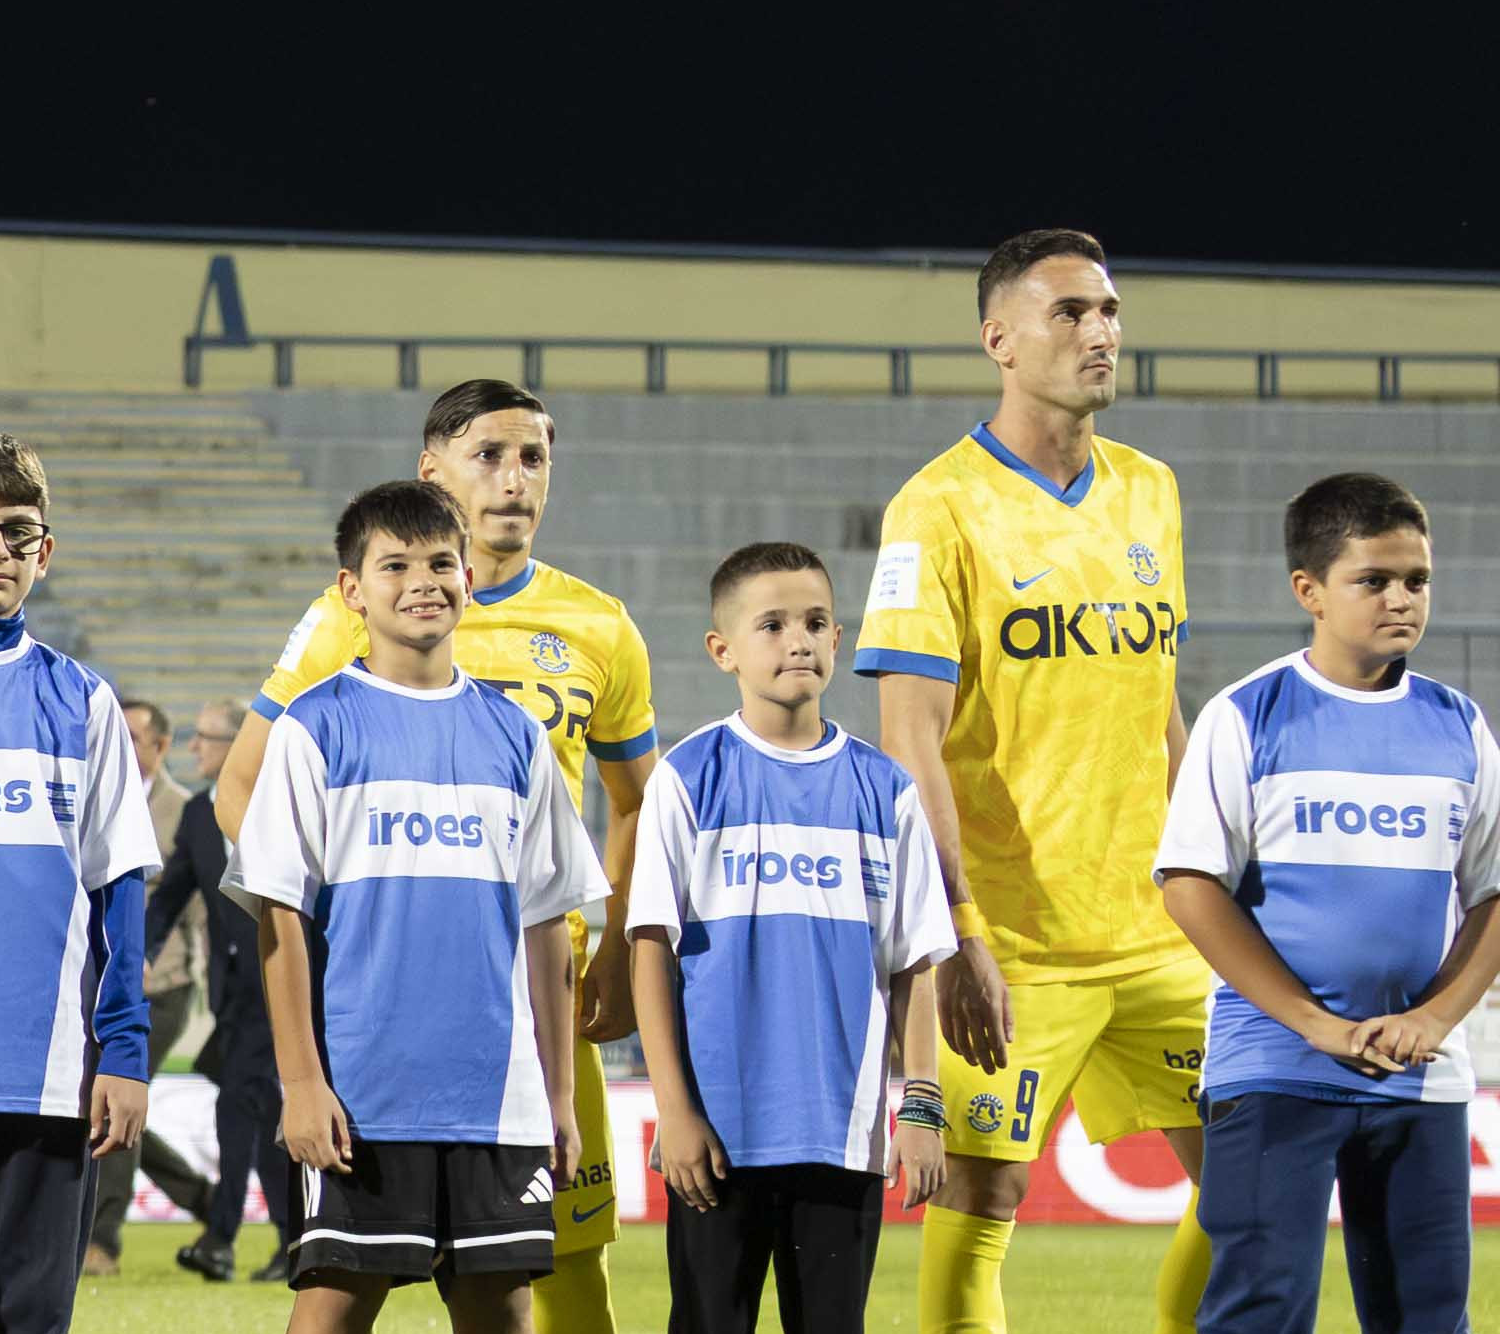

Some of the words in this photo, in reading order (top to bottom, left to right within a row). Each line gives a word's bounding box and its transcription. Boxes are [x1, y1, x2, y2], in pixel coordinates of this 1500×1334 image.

[368, 807, 484, 848] iroes
[1294, 796, 1427, 839] iroes
[722, 849, 843, 889] iroes
[1010, 1069, 1040, 1143] 9
